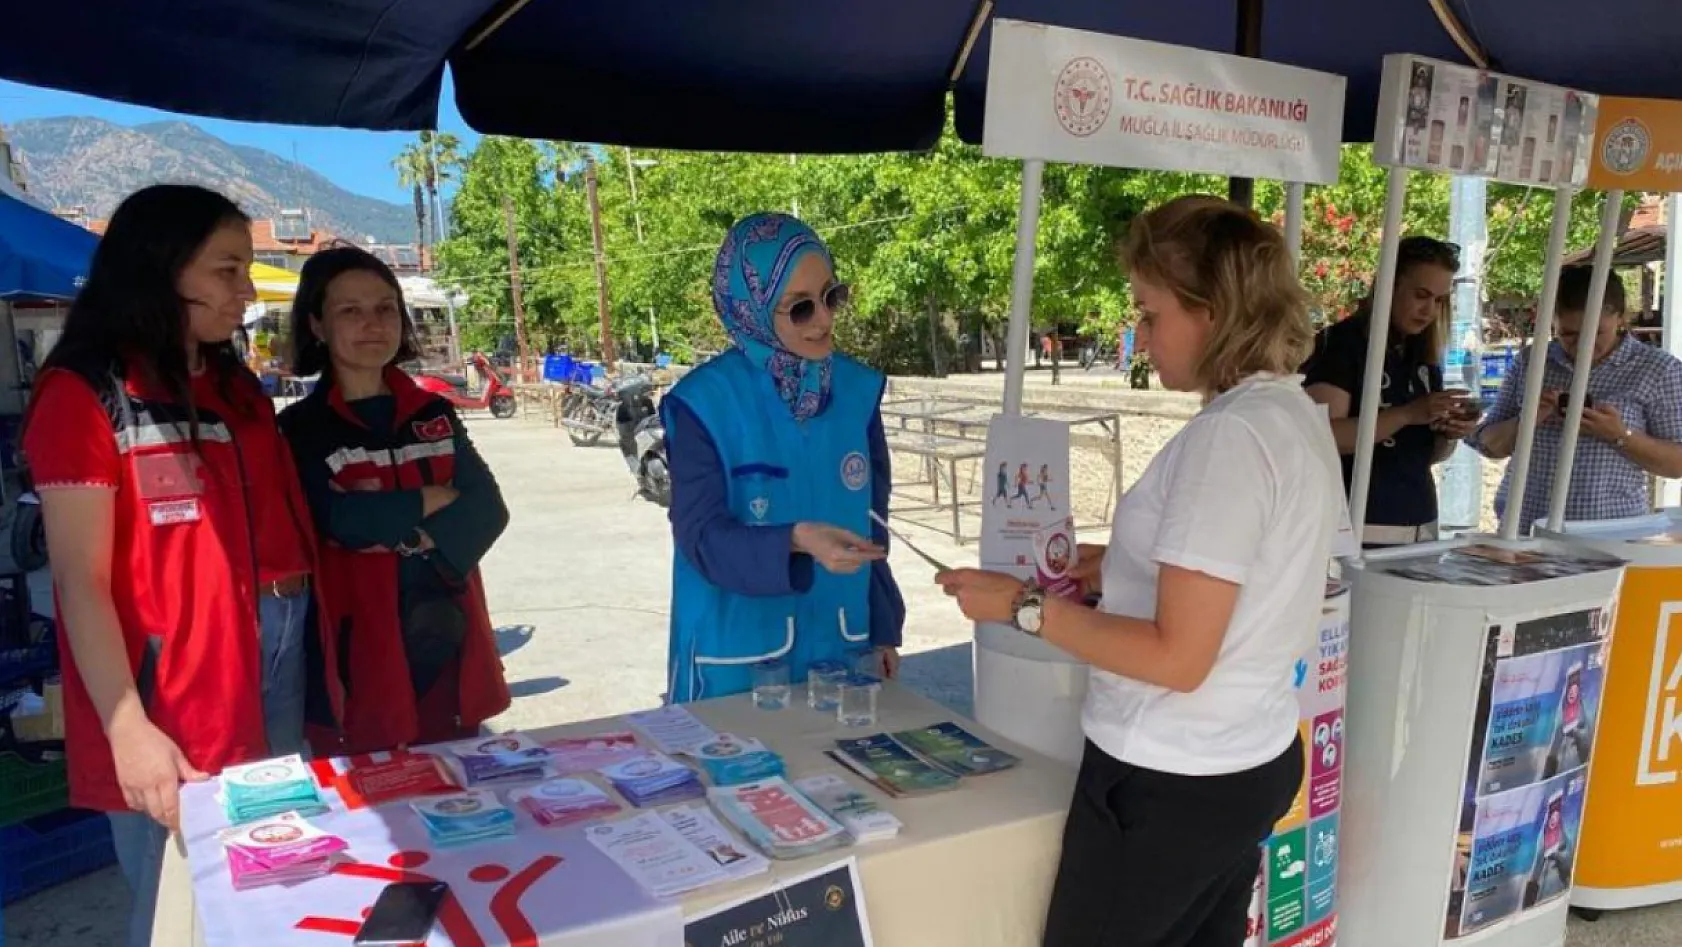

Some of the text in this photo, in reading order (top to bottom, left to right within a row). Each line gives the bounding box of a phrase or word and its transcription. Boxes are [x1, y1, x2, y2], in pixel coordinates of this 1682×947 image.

[1124, 77, 1308, 123] T.C. SAĞLIK BAKANLIĞI
[1120, 114, 1169, 137] MUĞLA
